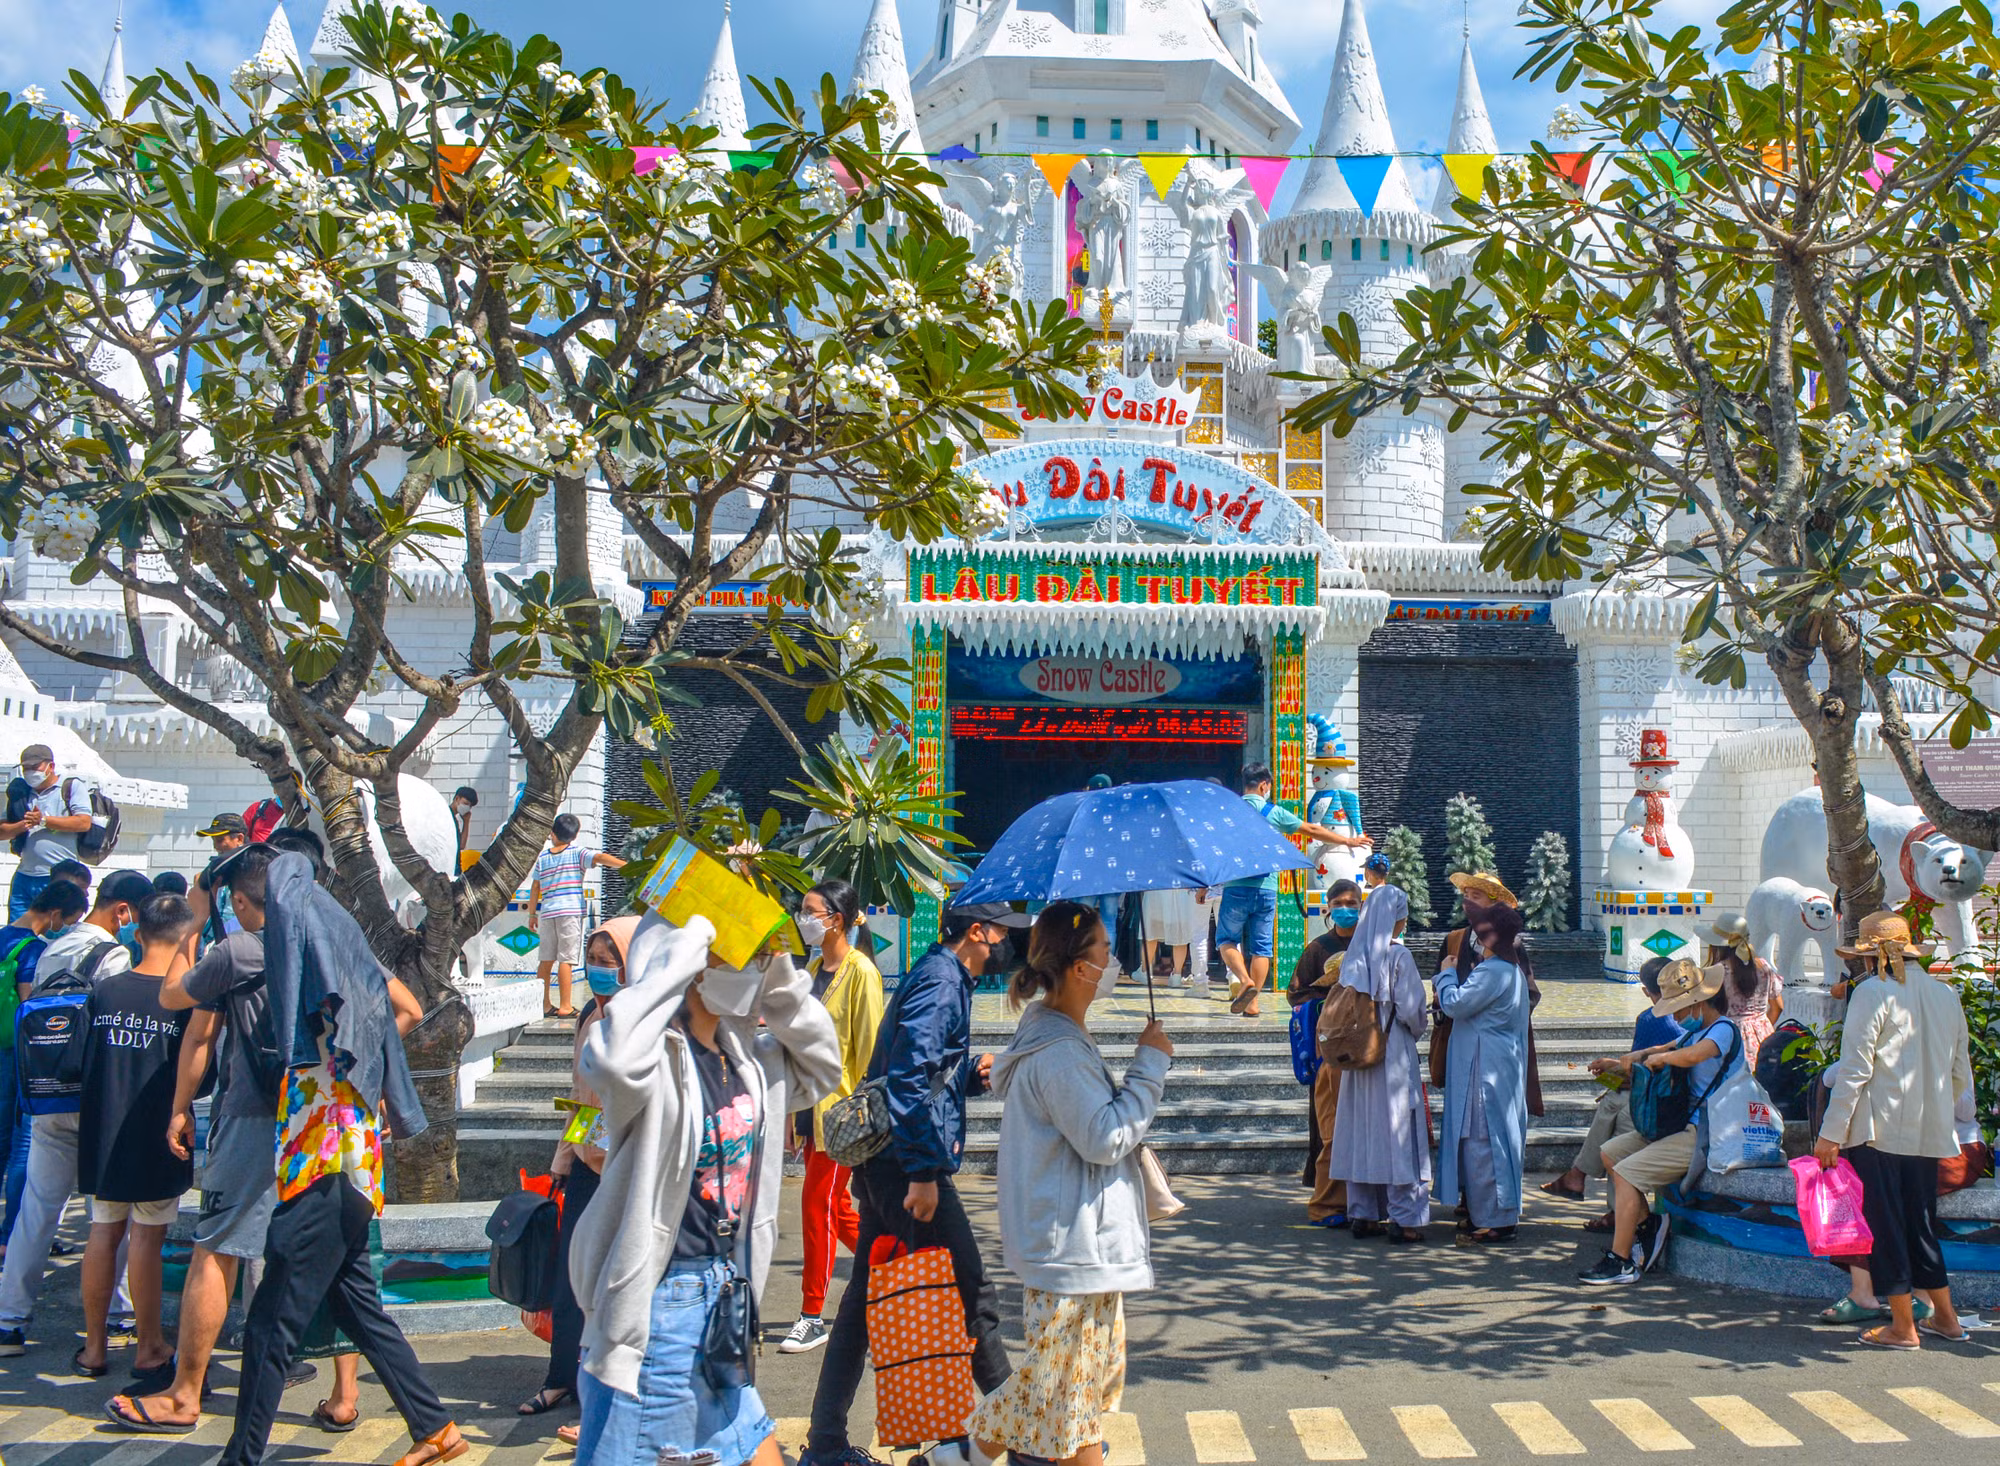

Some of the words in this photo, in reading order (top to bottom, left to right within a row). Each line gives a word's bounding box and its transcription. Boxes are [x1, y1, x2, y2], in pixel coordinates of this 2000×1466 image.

[1101, 386, 1189, 426] Castle
[1043, 455, 1127, 502] Đài
[920, 567, 1020, 603] LÂU
[1033, 566, 1121, 604] ĐÀI
[1136, 565, 1305, 606] TUYẾT
[1467, 603, 1535, 621] TUYẾT
[1037, 659, 1093, 692] Snow
[1100, 660, 1167, 693] Castle
[106, 1028, 157, 1050] ADLV
[125, 1013, 142, 1029] de
[144, 1015, 159, 1031] la
[161, 1020, 180, 1037] vie
